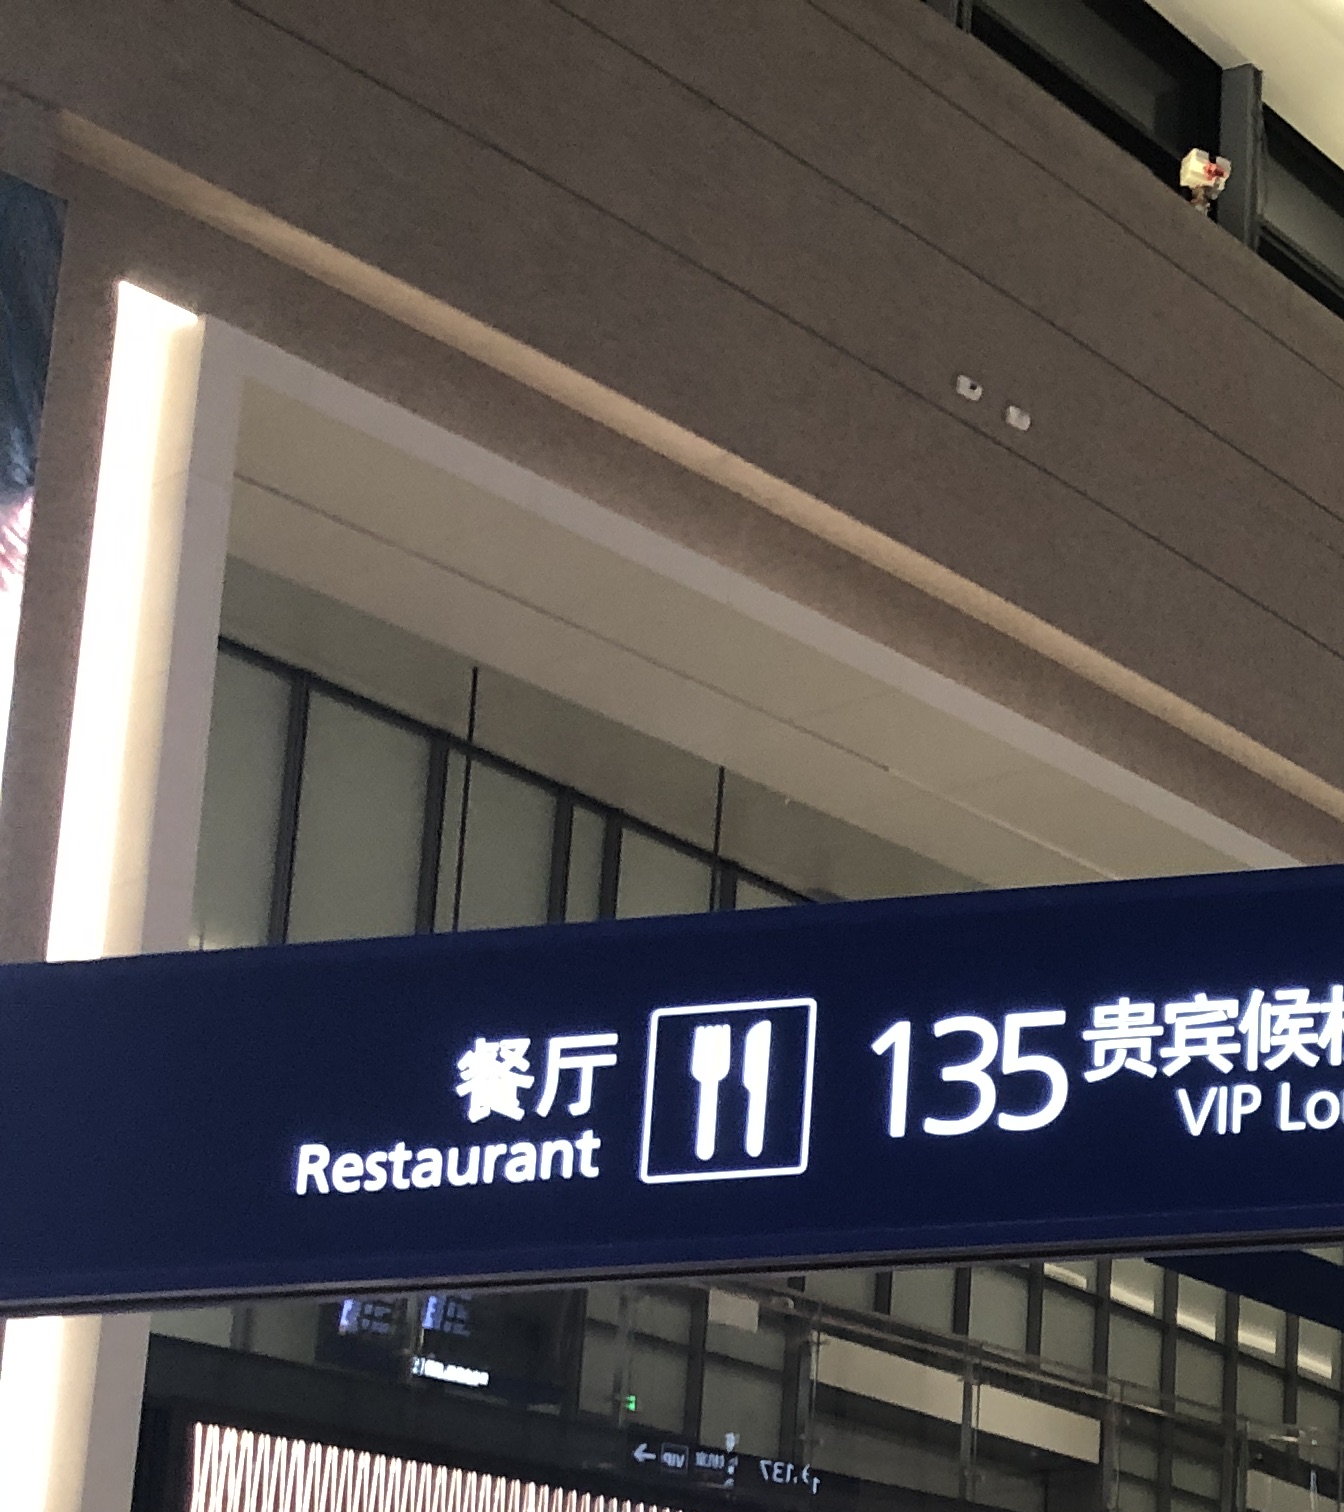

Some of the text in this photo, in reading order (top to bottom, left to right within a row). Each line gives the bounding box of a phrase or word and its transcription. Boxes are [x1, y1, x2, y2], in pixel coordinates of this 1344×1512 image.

[456, 1033, 618, 1122] 餐厅
[871, 1010, 1068, 1137] 135
[1177, 1084, 1261, 1136] VIP
[296, 1120, 600, 1195] Restaurant
